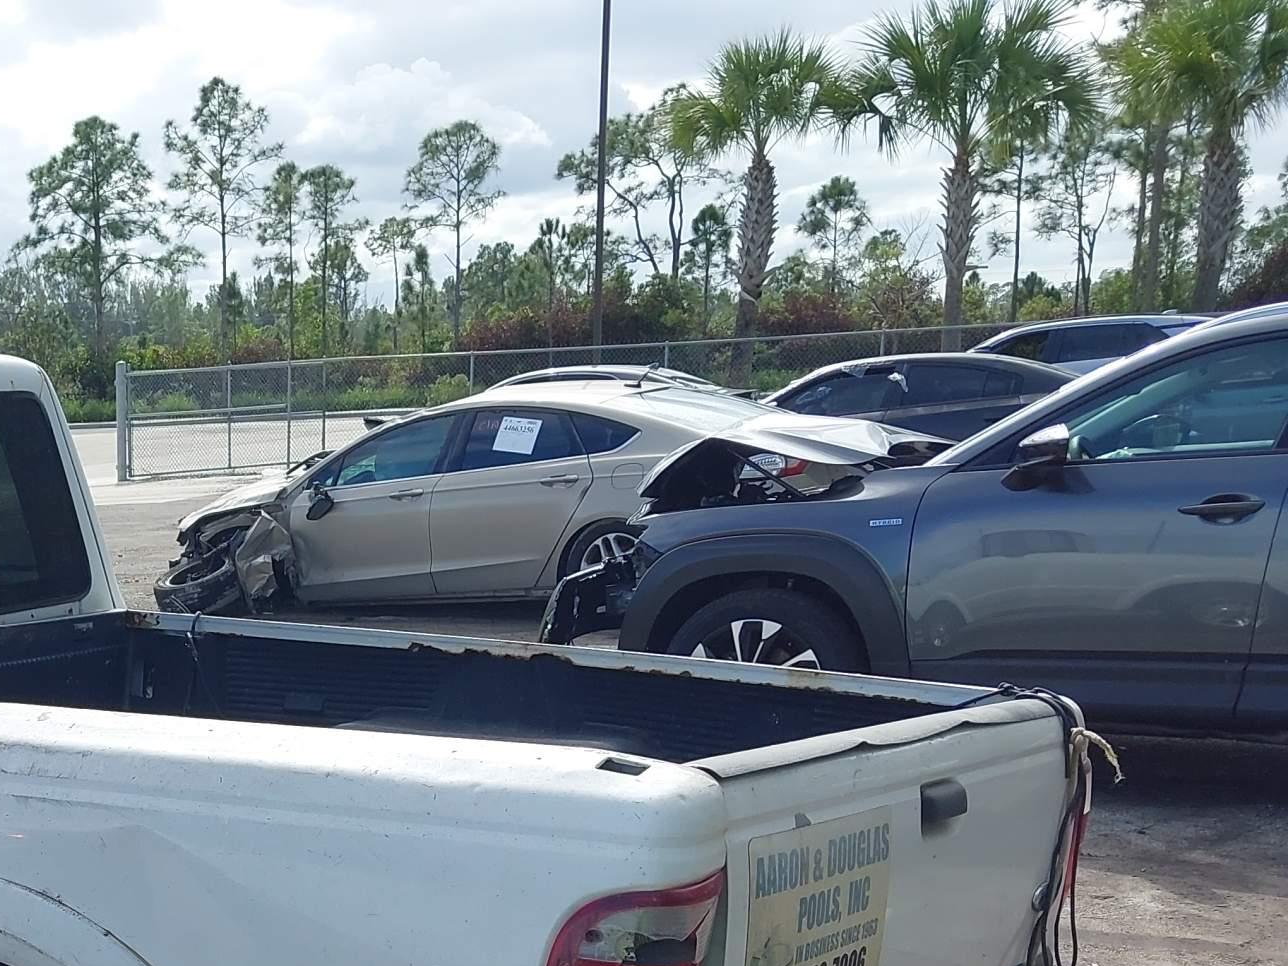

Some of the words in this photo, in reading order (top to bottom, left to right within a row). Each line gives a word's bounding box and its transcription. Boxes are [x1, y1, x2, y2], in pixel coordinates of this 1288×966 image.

[755, 846, 809, 899] AARON
[813, 848, 824, 882] &
[827, 823, 890, 878] DOUGLAS
[797, 885, 842, 933] POOLS,
[848, 876, 871, 915] INC
[795, 944, 805, 965] IN
[804, 931, 841, 962] BUSINESS
[840, 925, 861, 948] SINCE
